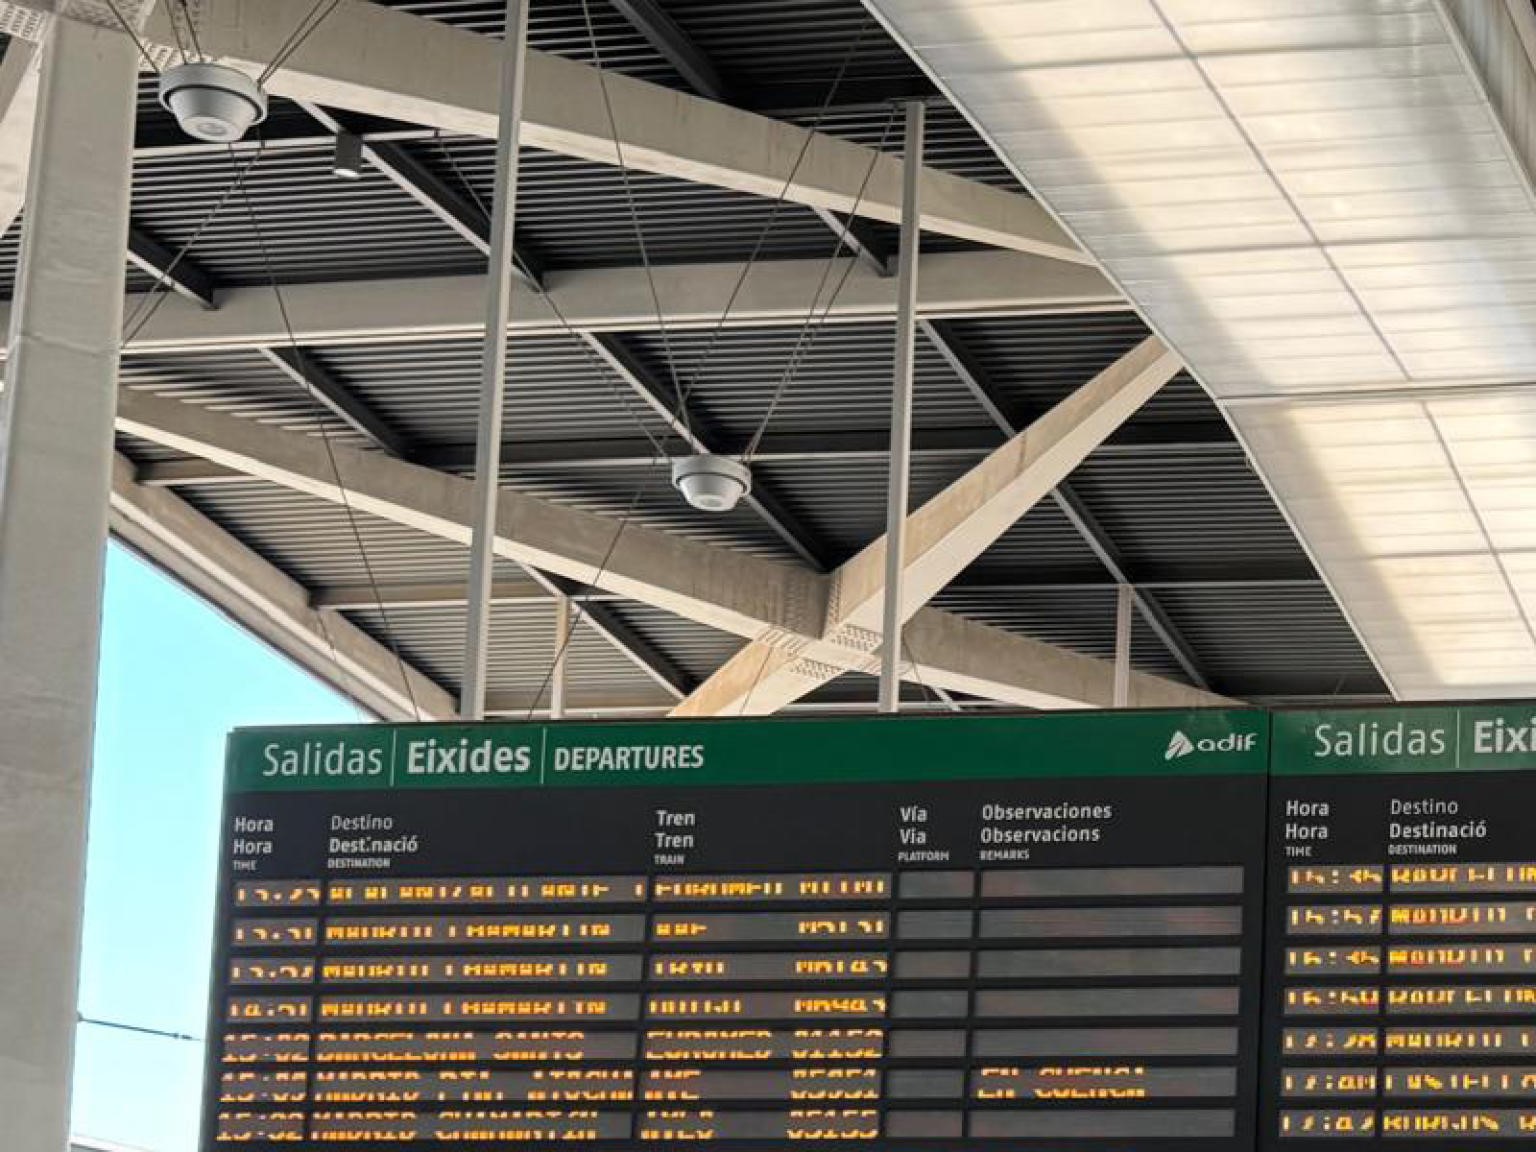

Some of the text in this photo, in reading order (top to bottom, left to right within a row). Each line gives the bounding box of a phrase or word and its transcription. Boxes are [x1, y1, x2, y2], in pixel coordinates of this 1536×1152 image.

[1197, 732, 1258, 752] adif
[1313, 720, 1446, 757] Salidas
[262, 738, 705, 777] Salidas Eixides DEPARTURES
[899, 804, 928, 822] Vía
[982, 802, 1113, 821] Observaciones
[1285, 800, 1330, 817] Hora
[1390, 799, 1459, 815] Destino
[234, 815, 274, 832] Hora
[330, 814, 393, 831] Destino
[656, 809, 696, 826] Tren
[980, 825, 1101, 844] Observacions
[1284, 823, 1328, 840] Hora
[1389, 820, 1487, 838] Destinació
[232, 838, 272, 855] Hora
[328, 835, 418, 853] Destinació
[654, 832, 694, 848] Tren
[898, 851, 950, 861] PLATFORM
[980, 849, 1030, 861] REMARKS
[1388, 844, 1458, 855] DESTINATION
[327, 858, 391, 868] DESTINATION
[654, 854, 685, 865] TRAIN
